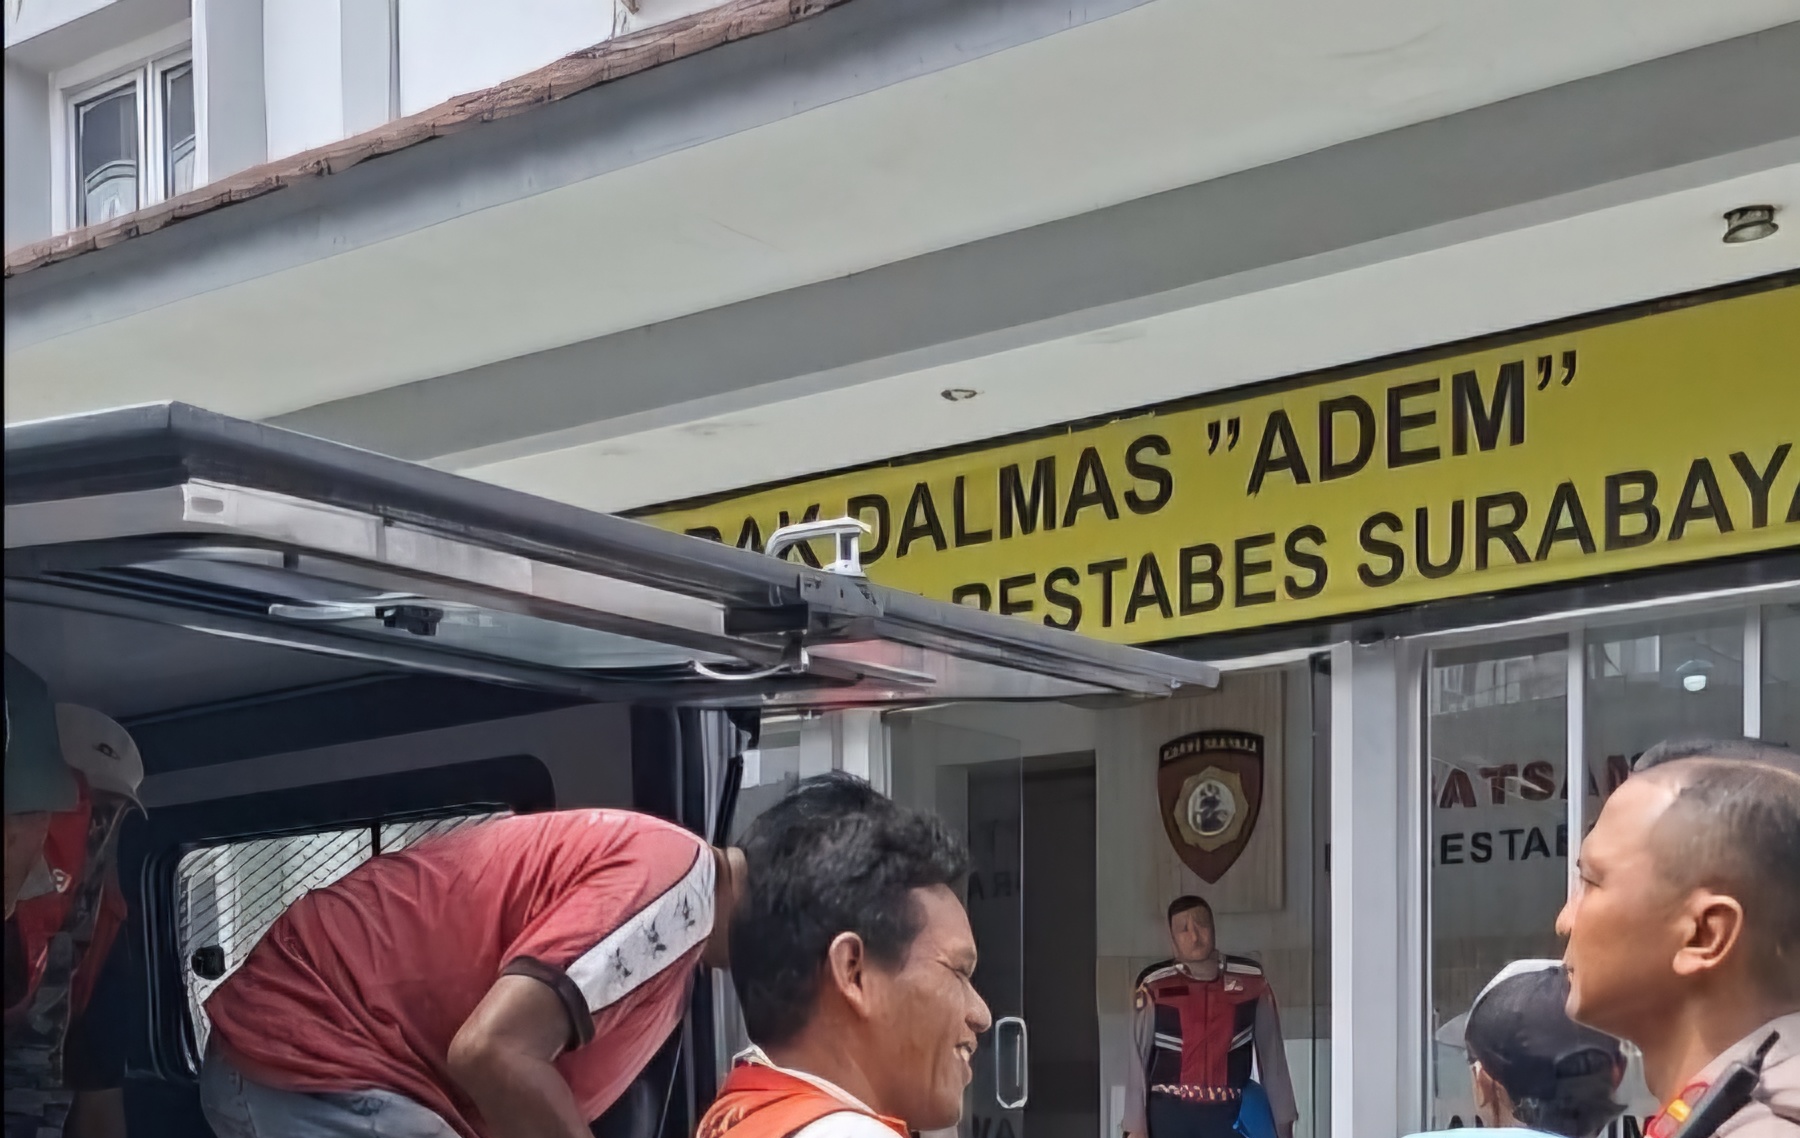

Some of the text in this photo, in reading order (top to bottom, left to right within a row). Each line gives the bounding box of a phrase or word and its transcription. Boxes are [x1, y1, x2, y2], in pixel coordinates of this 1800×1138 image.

[846, 434, 1173, 565] DALMAS
[1357, 443, 1800, 588] SURABAY
[1432, 824, 1569, 866] ESTA
